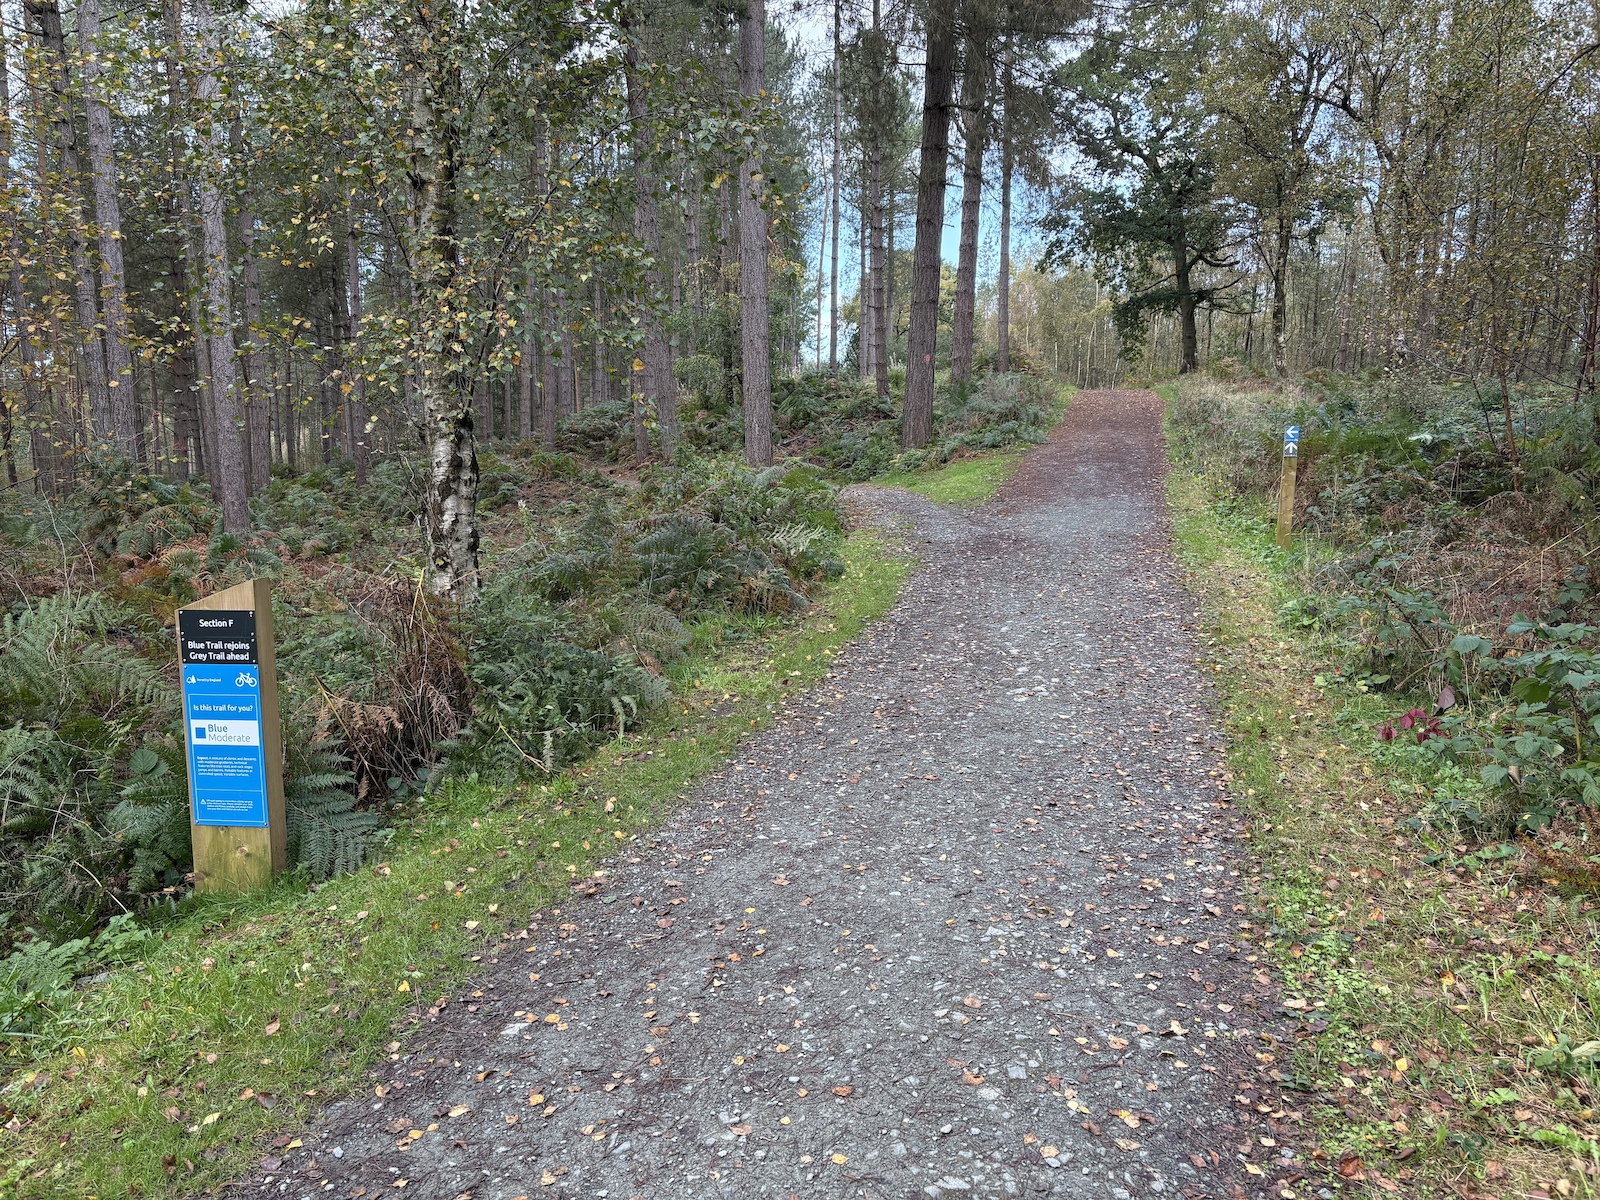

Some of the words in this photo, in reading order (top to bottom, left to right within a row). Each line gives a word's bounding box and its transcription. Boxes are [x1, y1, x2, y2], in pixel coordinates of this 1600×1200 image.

[199, 619, 228, 627] Section
[228, 619, 234, 627] F
[187, 641, 205, 649] Blue
[205, 641, 223, 650] Trail
[224, 641, 250, 651] rejoins
[189, 652, 208, 661] Grey
[208, 652, 225, 660] Trail
[226, 652, 250, 661] ahead
[227, 704, 237, 712] for
[238, 705, 253, 713] you?
[207, 724, 228, 732] Blue
[208, 733, 251, 743] Moderate
